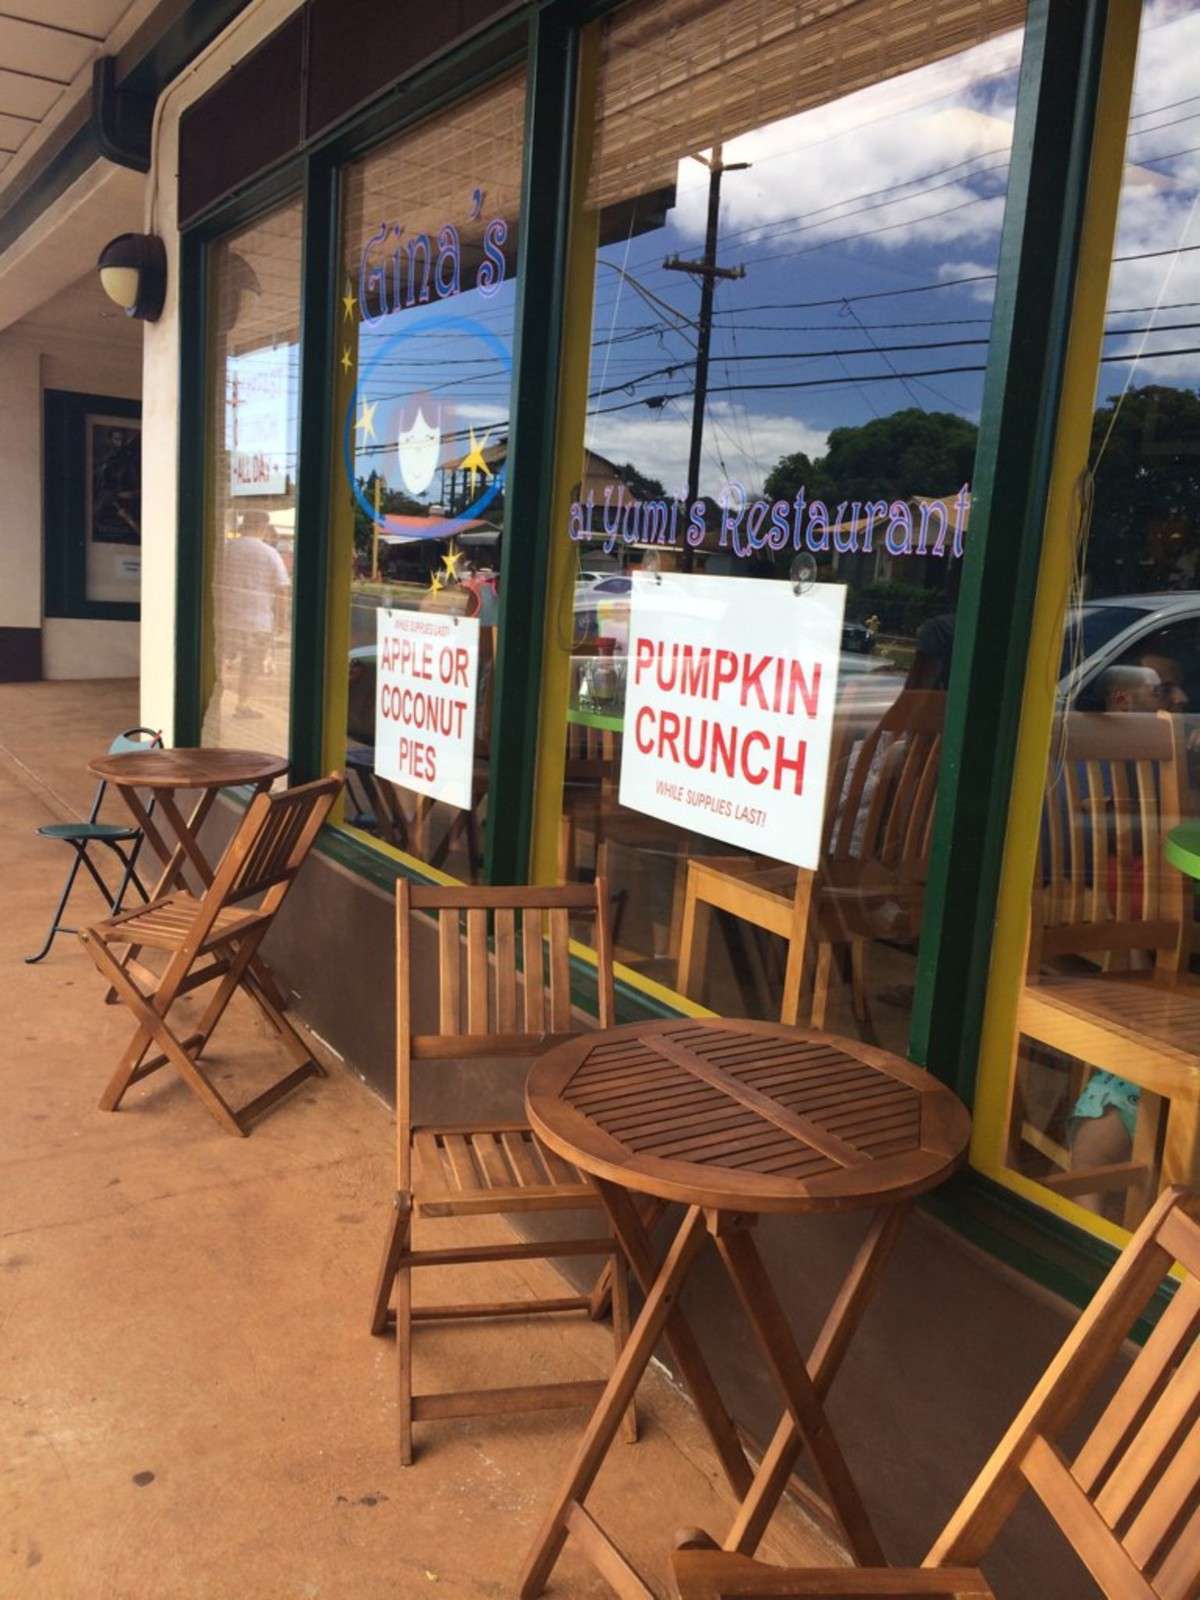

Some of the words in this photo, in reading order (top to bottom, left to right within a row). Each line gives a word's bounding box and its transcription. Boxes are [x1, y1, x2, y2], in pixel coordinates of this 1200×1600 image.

[359, 188, 508, 327] Gina's
[568, 489, 593, 541] at
[602, 482, 706, 554] Yumi's
[719, 480, 970, 557] Restaurant
[381, 637, 433, 680] APPLE
[439, 647, 470, 688] OR
[635, 637, 823, 720] PUMPKIN
[381, 683, 467, 740] COCONUT
[399, 737, 437, 783] PIES
[635, 705, 808, 796] CRUNCH
[656, 779, 685, 801] WHILE
[687, 790, 732, 817] SUPPLIES
[735, 804, 767, 827] LAST!
